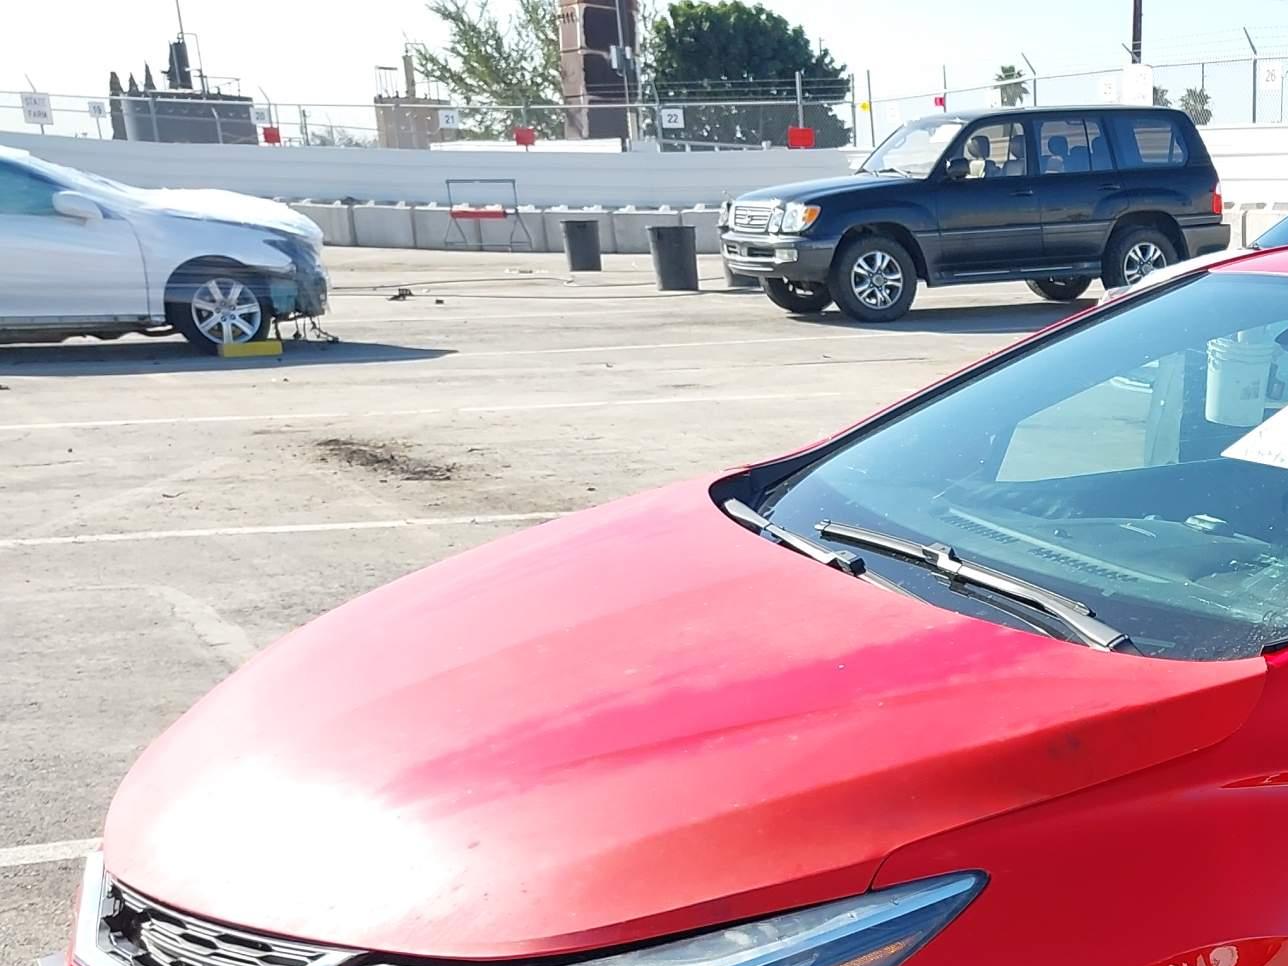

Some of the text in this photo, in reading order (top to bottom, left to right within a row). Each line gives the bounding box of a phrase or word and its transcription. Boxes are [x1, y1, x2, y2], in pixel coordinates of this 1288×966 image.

[1265, 69, 1276, 82] 26
[444, 114, 455, 124] 21
[666, 113, 679, 124] 22
